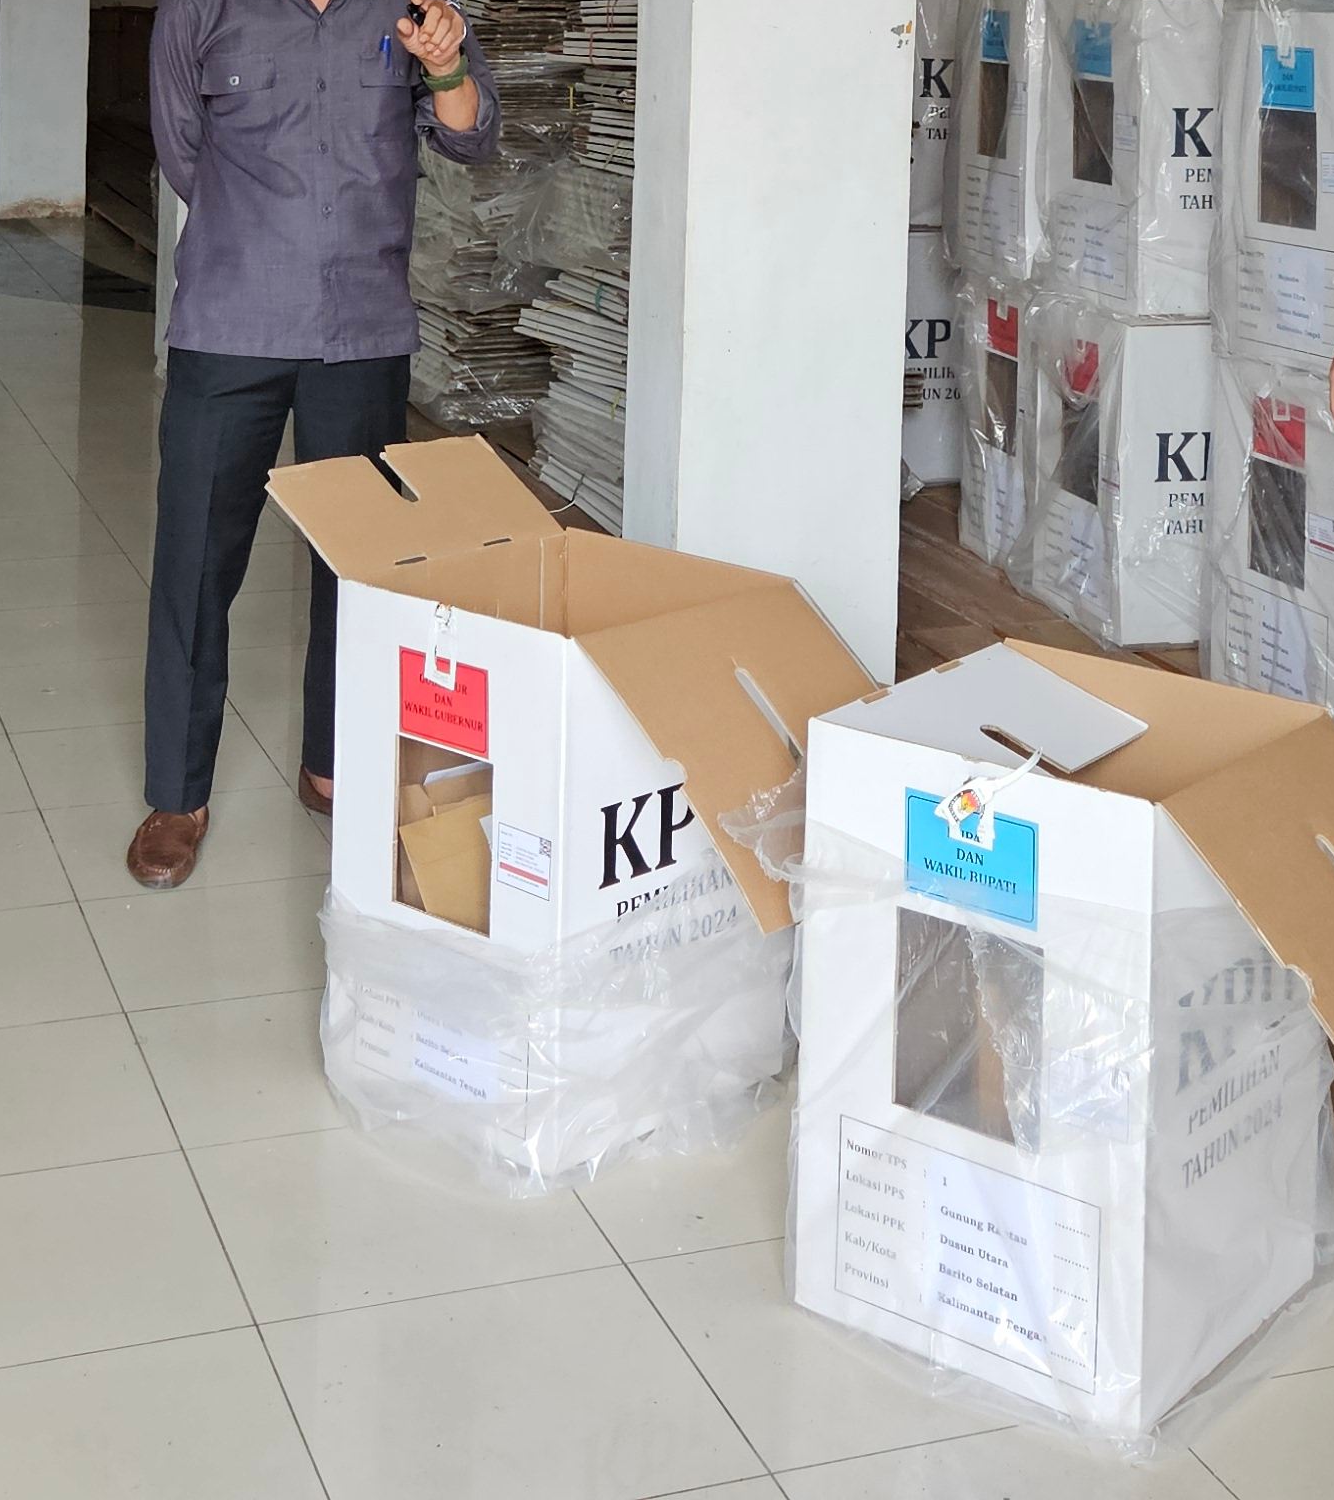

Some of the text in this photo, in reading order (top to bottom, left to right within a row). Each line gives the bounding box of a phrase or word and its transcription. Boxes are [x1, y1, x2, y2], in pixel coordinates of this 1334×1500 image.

[1180, 195, 1213, 209] TAH
[905, 319, 951, 359] KP
[1166, 520, 1203, 534] TAH
[405, 701, 483, 732] WAKIL GUBERNUR
[435, 693, 452, 707] DAN
[598, 782, 696, 889] KP
[957, 848, 984, 865] DAN
[924, 858, 1017, 894] WAKIL BUPATI
[1187, 1045, 1280, 1136] PEMILIHAN
[847, 1138, 947, 1187] Nomor TPS 1
[1182, 1094, 1283, 1189] TAHUN 2024
[846, 1170, 1028, 1246] Lokasi PPS Gunung Ratau
[845, 1200, 1009, 1269] Lokasi PPK Dusun Utara
[845, 1231, 1018, 1302] Kab/Kota Barito Selatan
[844, 1262, 1047, 1342] Provinsi Kalimantan Tenga
